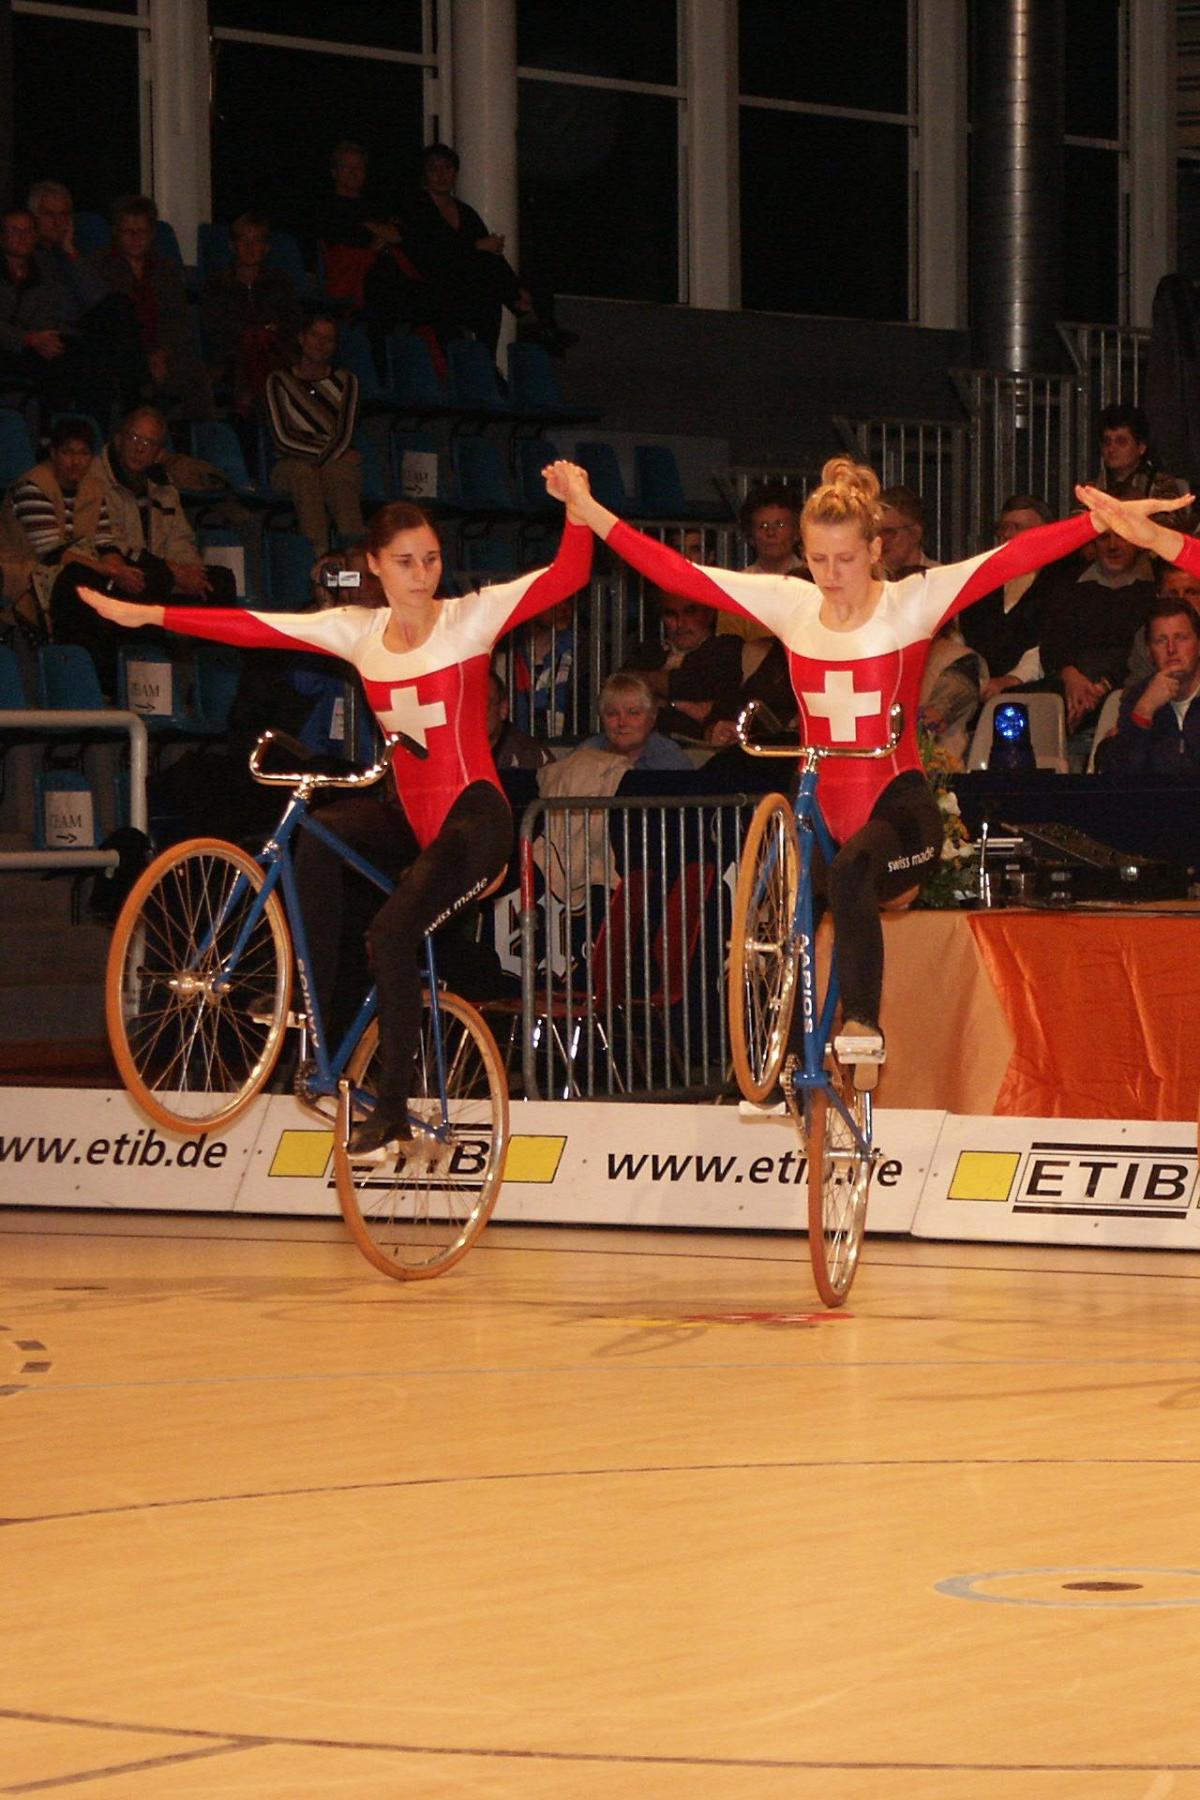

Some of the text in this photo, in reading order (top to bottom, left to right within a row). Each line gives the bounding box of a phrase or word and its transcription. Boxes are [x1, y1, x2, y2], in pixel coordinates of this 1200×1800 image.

[888, 846, 935, 873] swiss made
[607, 1149, 902, 1187] www.eti.e
[1026, 1160, 1189, 1200] ETIB
